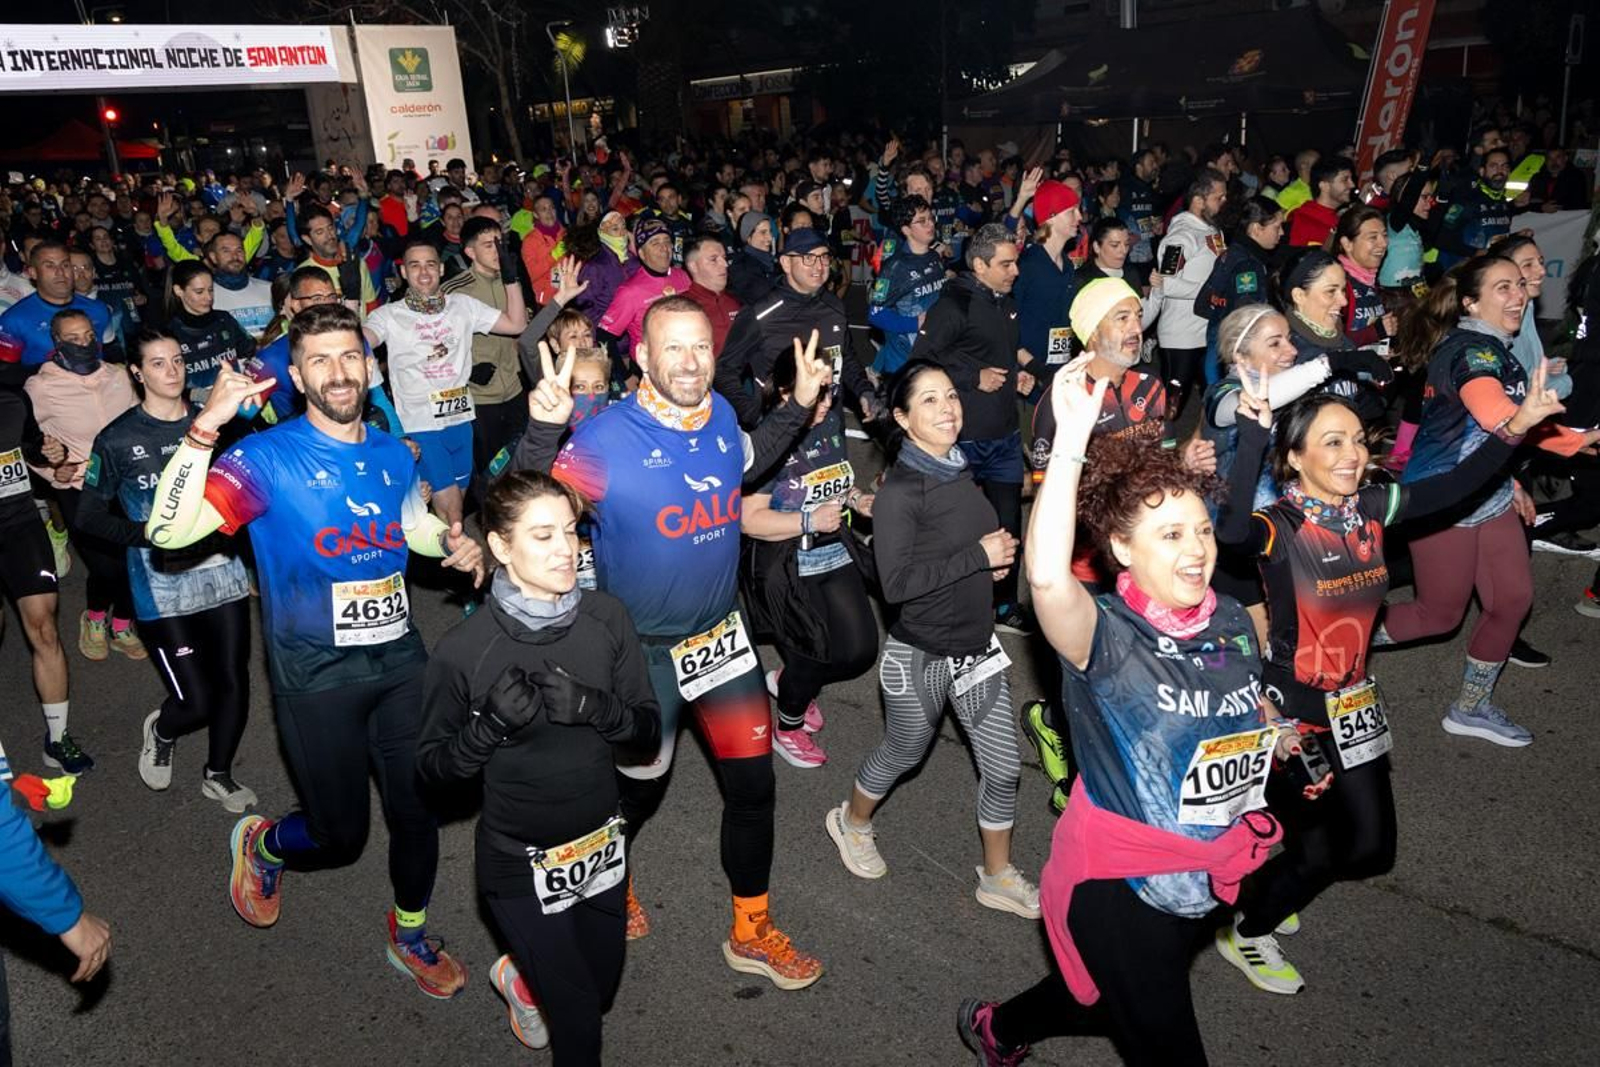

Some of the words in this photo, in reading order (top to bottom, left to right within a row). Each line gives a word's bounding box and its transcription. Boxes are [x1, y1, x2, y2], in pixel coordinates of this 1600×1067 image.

[8, 48, 163, 71] INTERNACIONAL
[165, 47, 220, 68] NOCHE
[222, 47, 245, 68] DE
[247, 46, 278, 67] SAN
[185, 360, 210, 374] SAN
[1505, 381, 1526, 396] SA
[435, 396, 468, 413] 7728
[0, 462, 23, 480] 90
[138, 471, 163, 490] SA
[160, 462, 193, 521] LURBEL
[811, 476, 850, 500] 5664
[693, 528, 726, 545] SPORT
[351, 550, 383, 564] SPORT
[341, 592, 405, 621] 4632
[680, 630, 737, 675] 6247
[1157, 683, 1210, 718] SAN
[1216, 674, 1263, 717] ANTÓ
[1340, 703, 1384, 739] 5438
[1186, 751, 1269, 794] 10005
